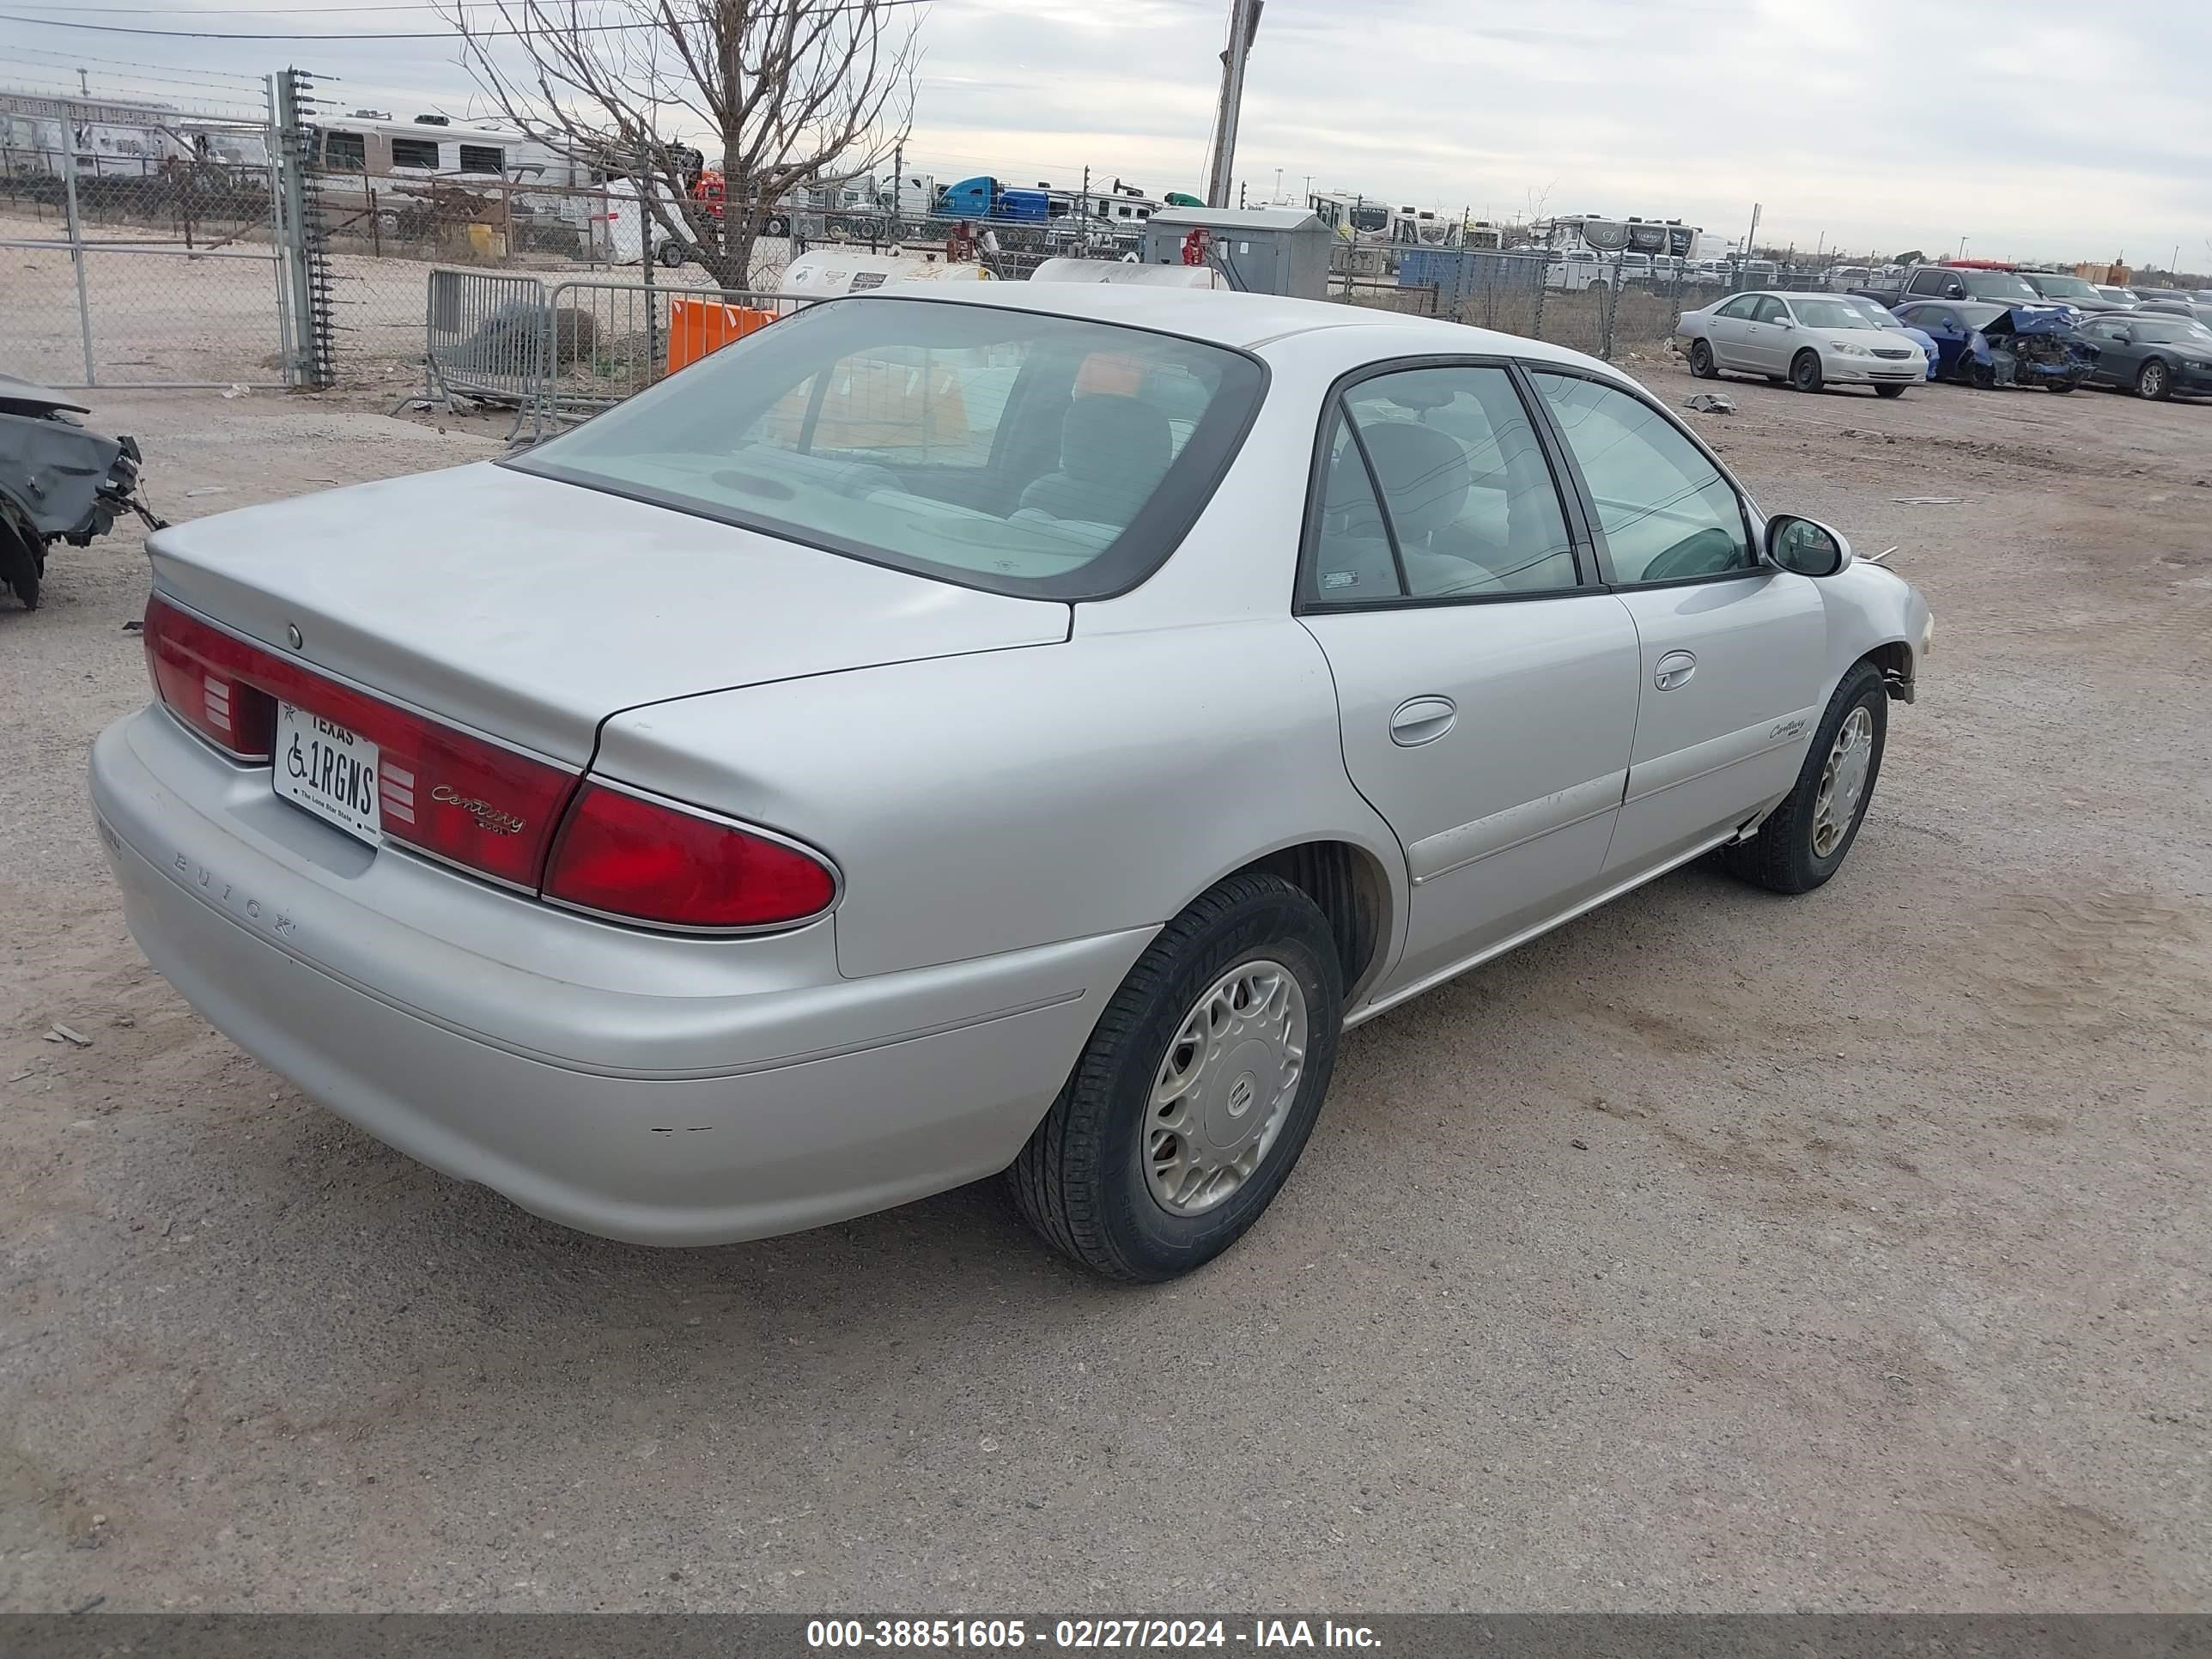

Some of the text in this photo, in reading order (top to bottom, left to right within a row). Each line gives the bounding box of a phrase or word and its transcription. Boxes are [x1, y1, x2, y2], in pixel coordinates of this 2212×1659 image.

[313, 716, 355, 746] TEXAS
[1770, 719, 1807, 739] Century
[309, 740, 374, 816] 1RGNS
[301, 789, 352, 823] The Lone Star State
[431, 785, 526, 834] Century
[173, 852, 290, 937] BUICK
